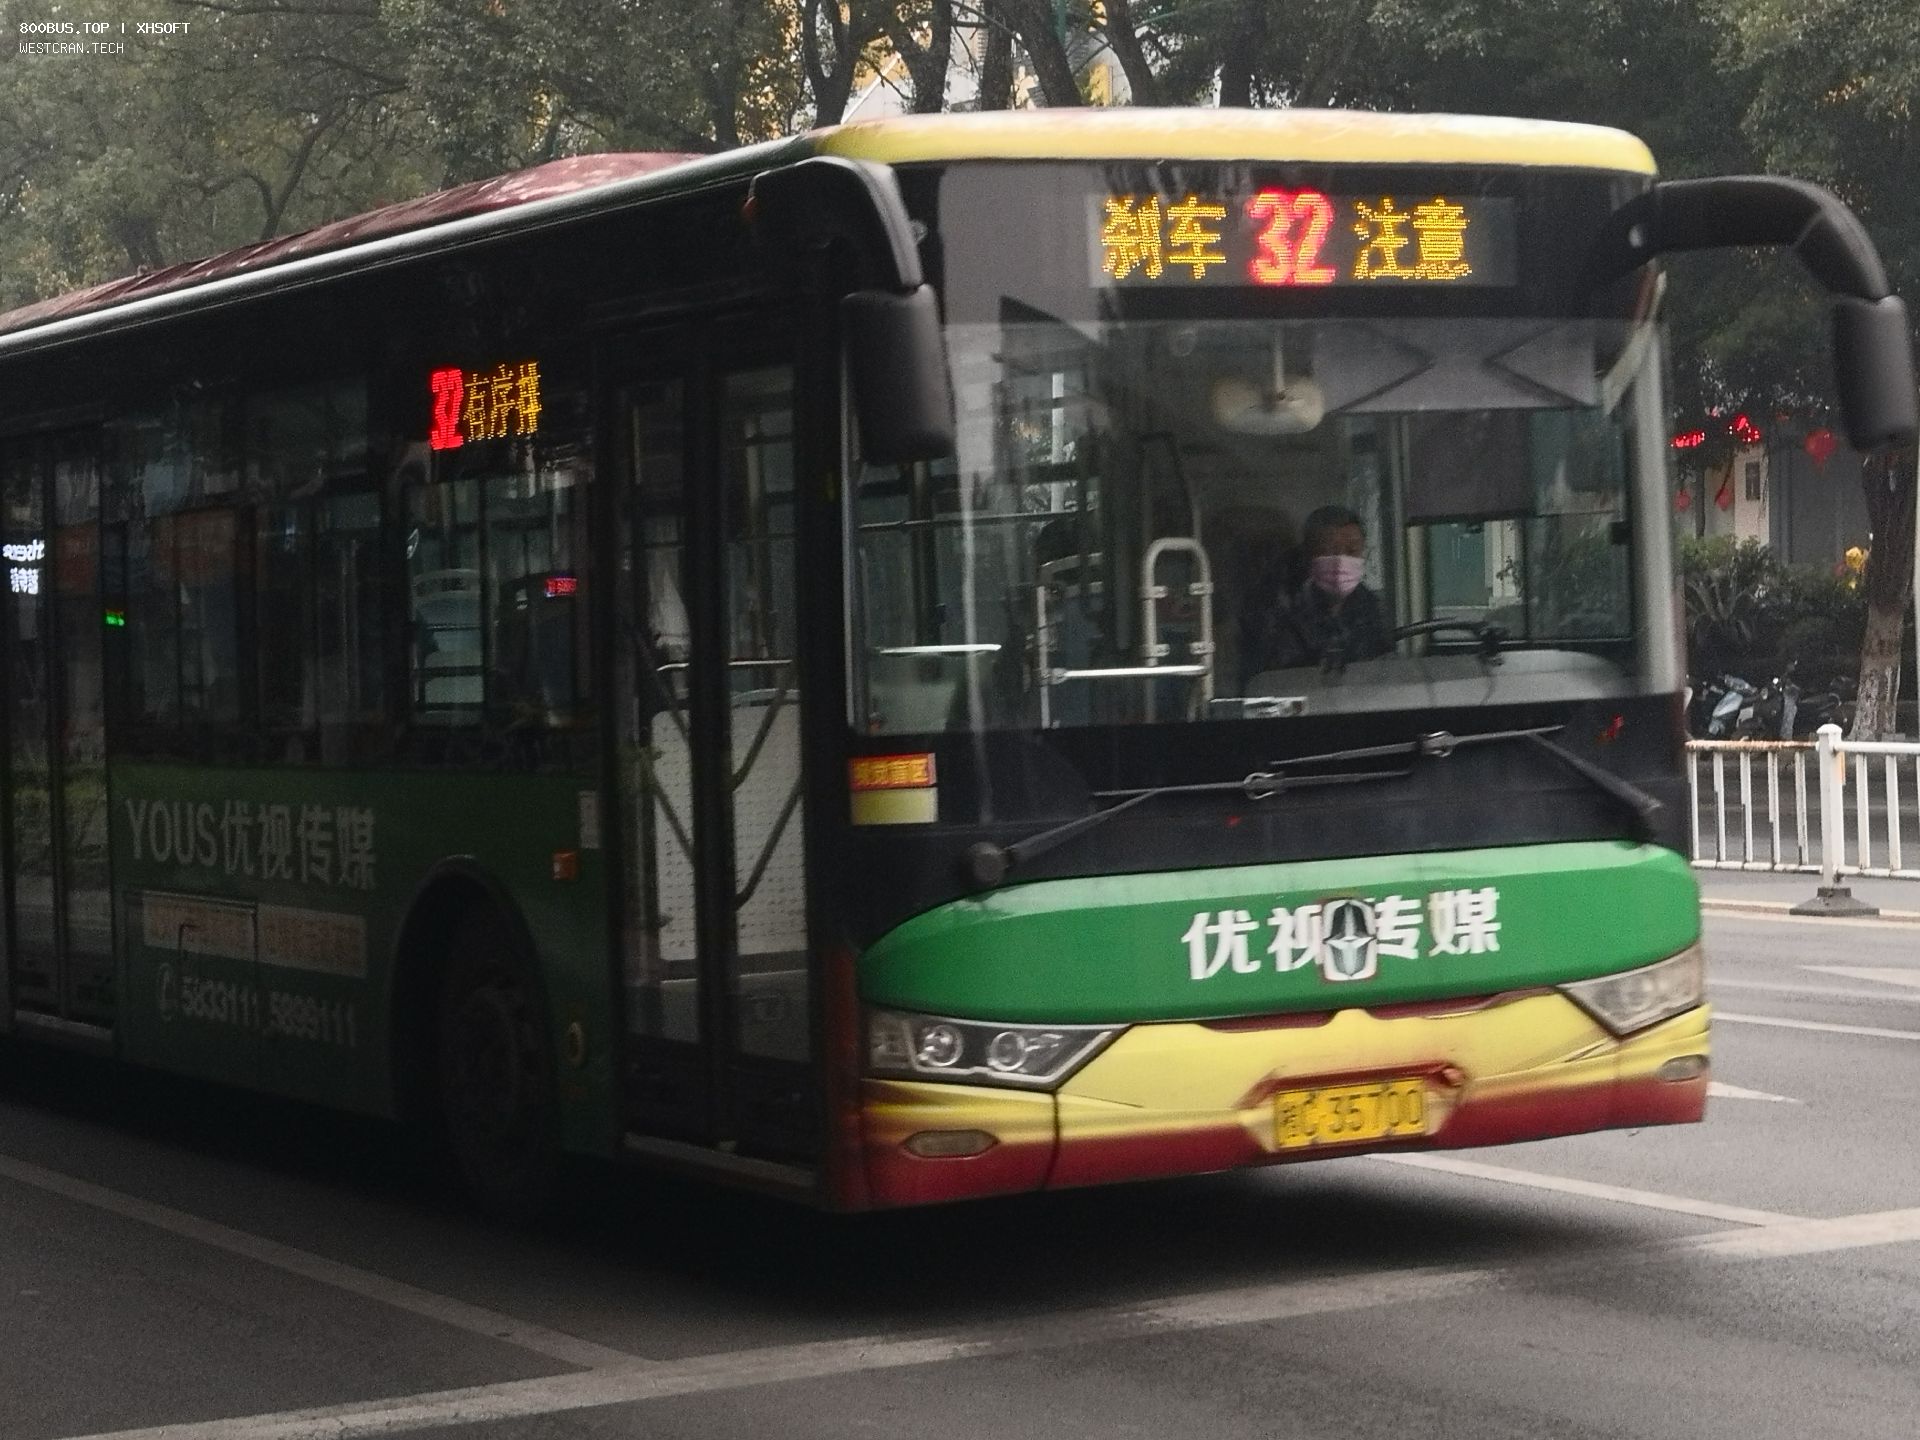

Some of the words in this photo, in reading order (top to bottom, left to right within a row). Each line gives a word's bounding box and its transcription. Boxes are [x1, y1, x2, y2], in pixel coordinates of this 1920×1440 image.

[1101, 196, 1228, 280] 刹车
[1248, 188, 1337, 284] 32
[1353, 196, 1473, 281] 注意
